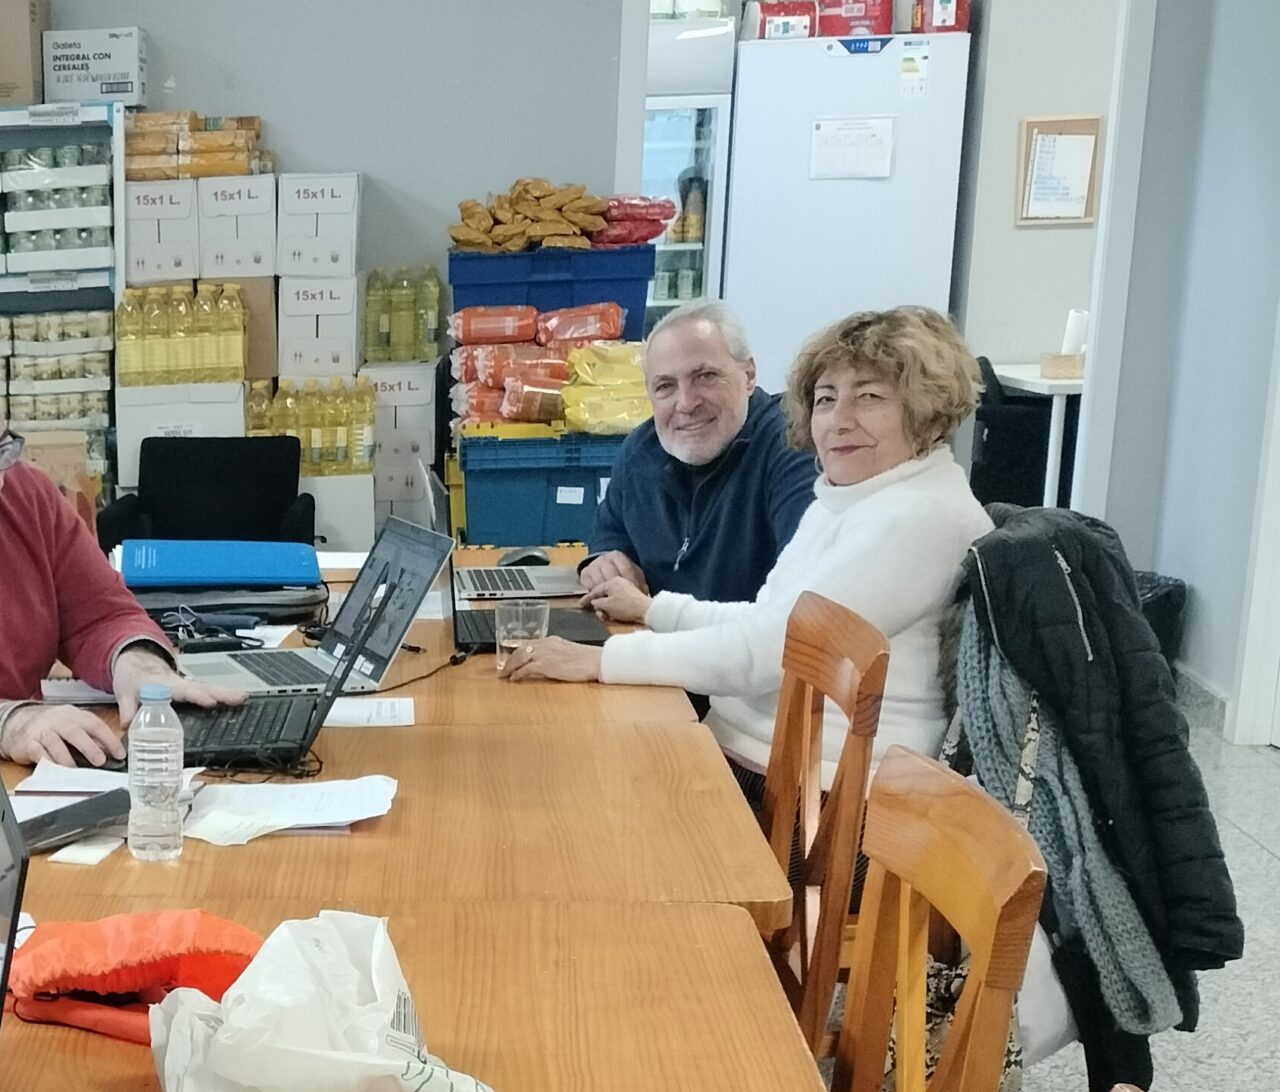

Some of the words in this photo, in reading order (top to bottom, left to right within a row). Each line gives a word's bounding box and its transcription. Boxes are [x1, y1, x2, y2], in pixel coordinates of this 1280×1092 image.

[52, 42, 81, 50] Galleta
[52, 53, 90, 62] INTEGRAL
[92, 52, 111, 60] CON
[52, 63, 90, 72] CEREALES
[213, 189, 242, 201] 15x1
[247, 189, 259, 199] L.
[295, 188, 325, 200] 15x1
[331, 188, 342, 199] L.
[135, 194, 164, 206] 15x1
[169, 194, 180, 205] L.
[294, 290, 323, 301] 15x1
[329, 290, 340, 300] L.
[372, 381, 402, 392] 15x1
[407, 381, 419, 391] L.
